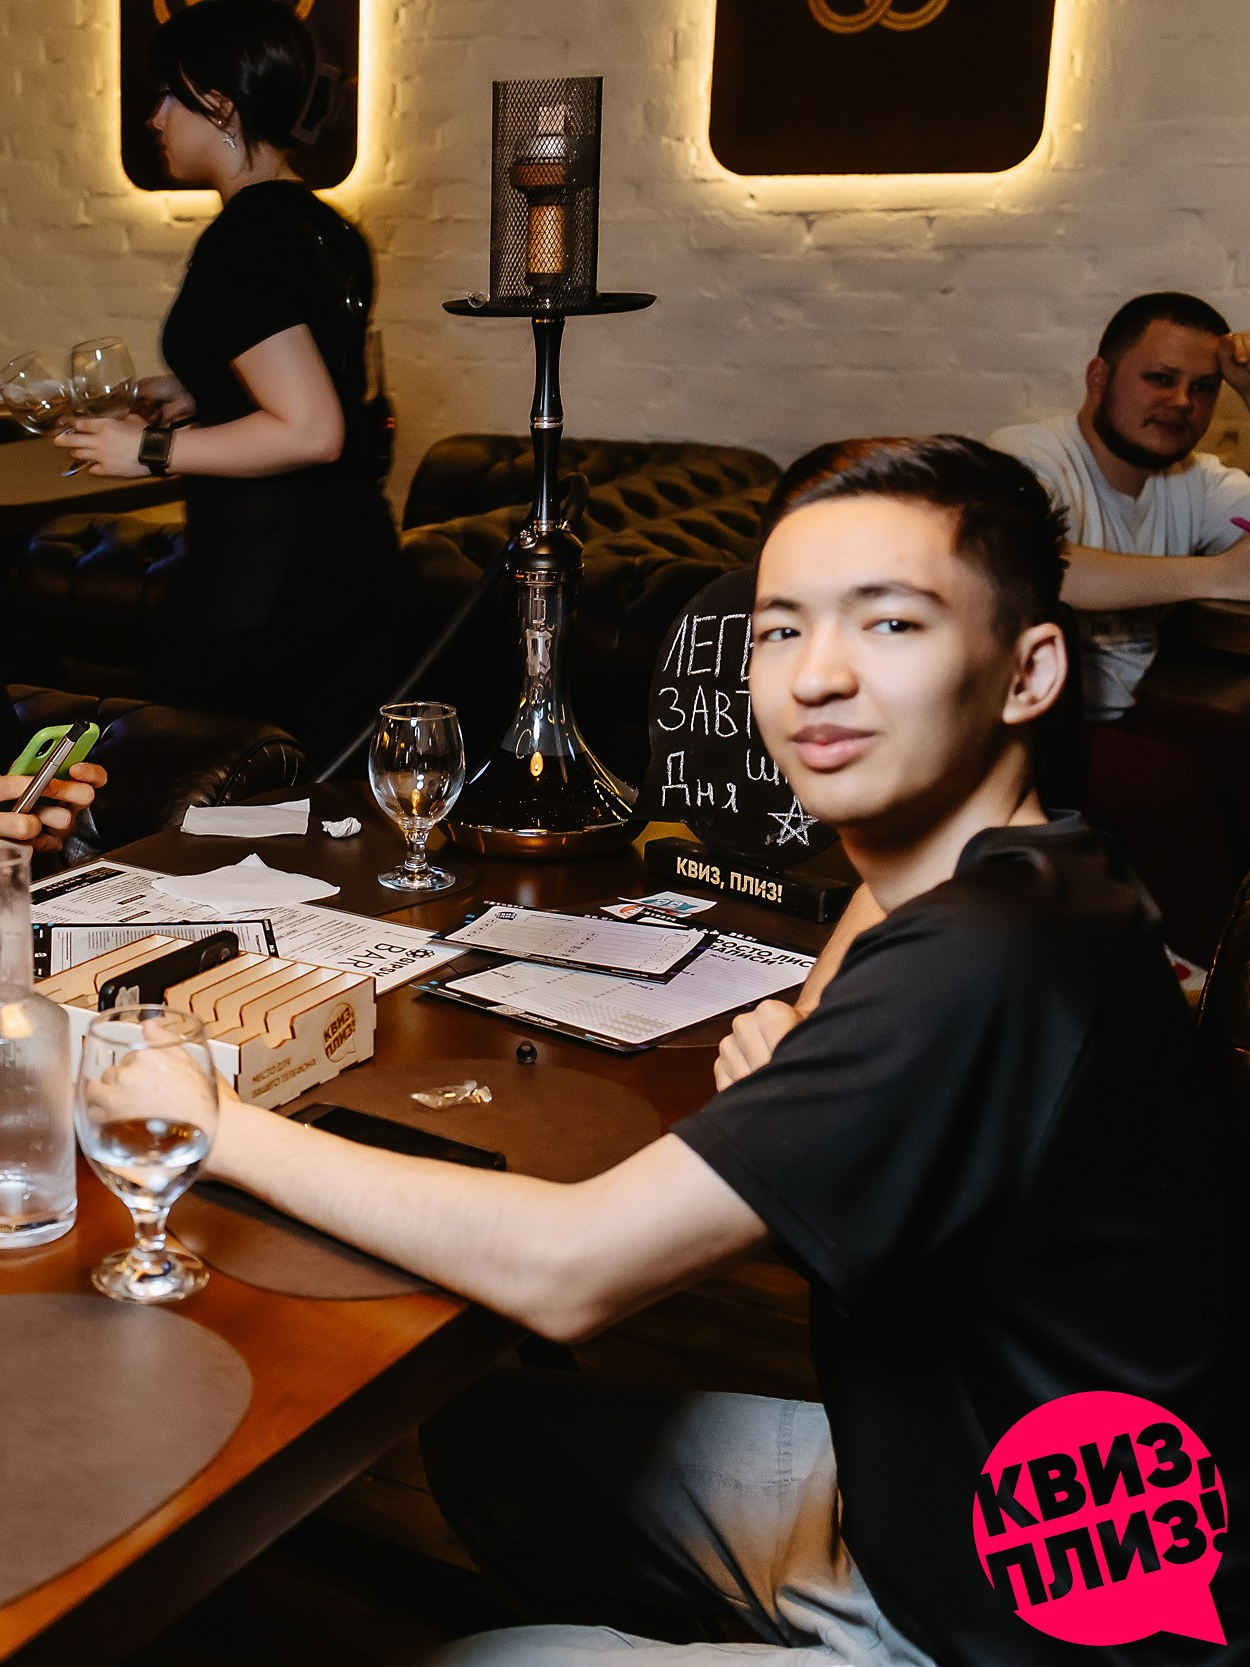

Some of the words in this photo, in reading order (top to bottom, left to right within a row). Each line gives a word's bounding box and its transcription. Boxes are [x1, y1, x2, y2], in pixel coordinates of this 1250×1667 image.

[657, 685, 751, 739] ЗАВТ
[676, 857, 725, 889] КВИЗ,
[729, 871, 783, 903] ПЛИЗ!
[337, 943, 407, 969] BAR
[371, 957, 416, 977] GIPSY
[715, 938, 773, 957] РОСТО
[772, 954, 815, 968] ЛИС
